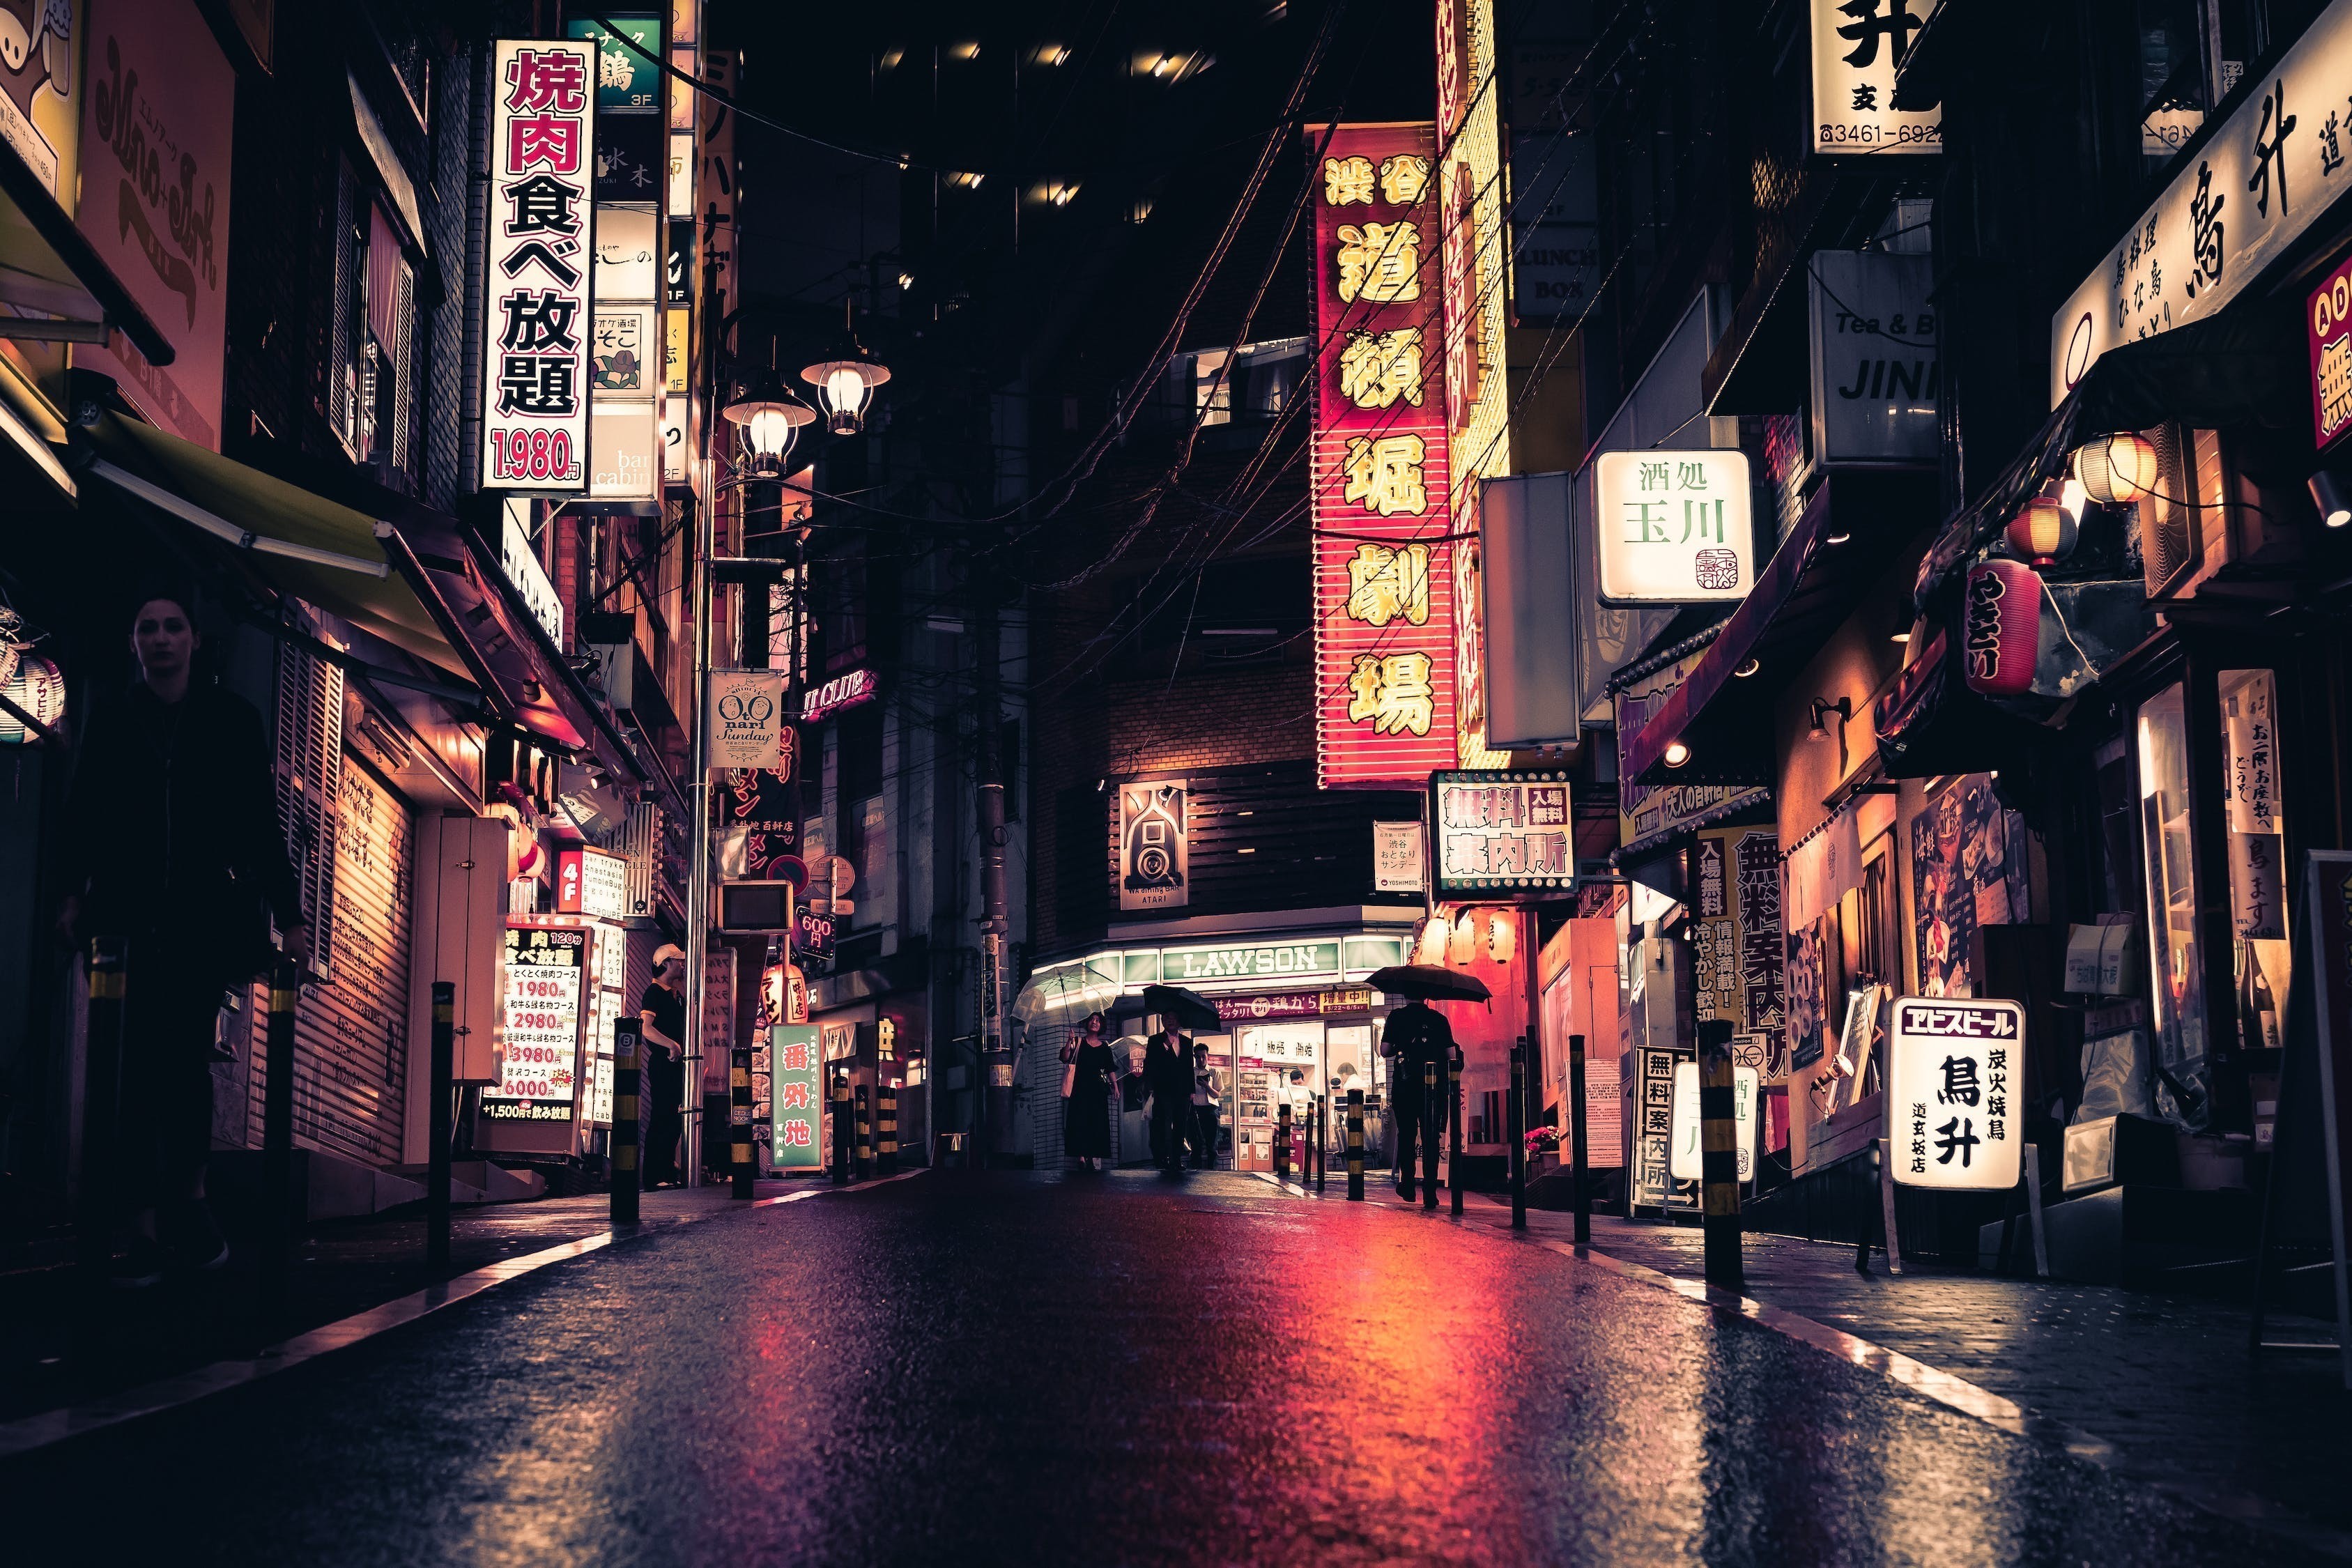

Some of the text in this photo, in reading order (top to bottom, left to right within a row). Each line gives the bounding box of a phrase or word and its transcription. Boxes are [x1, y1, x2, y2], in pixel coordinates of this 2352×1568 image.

[631, 95, 651, 105] 3F
[1325, 155, 1431, 207] 渋谷
[2186, 78, 2296, 298] 鳥升
[498, 49, 587, 417] 焼肉食べ放題
[2114, 213, 2158, 289] 鳥料理
[2119, 259, 2161, 328] ひな鳥
[1836, 313, 1880, 334] Tea
[2128, 301, 2171, 343] きとり
[594, 330, 636, 348] そこ
[671, 379, 683, 390] 1F
[491, 429, 581, 481] 1,980円
[618, 449, 651, 468] bar
[596, 466, 652, 486] cabin
[665, 468, 679, 479] 2F
[1337, 222, 1435, 736] 道頓堀劇場
[1639, 461, 1707, 491] 酒処
[1623, 499, 1724, 544] 玉川
[820, 670, 864, 707] CLUB
[716, 729, 774, 744] Sunday
[1444, 787, 1525, 828] 無料
[1532, 790, 1563, 806] 入場
[1532, 807, 1564, 824] 無料
[763, 821, 794, 831] 百軒店
[1389, 840, 1407, 848] 渋谷
[1446, 831, 1567, 874] 案内所
[601, 859, 622, 870] tryke
[1381, 850, 1415, 859] おとなり
[585, 864, 622, 879] Anastasia
[1381, 861, 1416, 869] サンデー
[563, 863, 578, 901] 4F
[1700, 841, 1723, 916] 入場無料
[1142, 896, 1167, 904] ATARI
[584, 905, 620, 919] A-TROUPE
[802, 915, 831, 936] 600
[551, 933, 582, 945] 120分
[810, 934, 822, 948] 円
[1183, 945, 1319, 978] LAWSON
[1714, 921, 1737, 1008] 情報満載!
[514, 969, 577, 978] とくとく焼肉コース
[516, 981, 566, 997] 1980円
[762, 977, 780, 1024] ラーメン
[1254, 1000, 1267, 1014] 新
[513, 1013, 563, 1029] 2980円
[512, 1047, 561, 1064] 3980円
[504, 1080, 555, 1096] 6000円
[783, 1043, 811, 1146] 番外地
[1988, 1048, 2008, 1141] 炭火焼鳥
[1646, 1054, 1671, 1186] 無料案内所
[1935, 1055, 1981, 1169] 鳥升
[776, 1123, 785, 1158] 百軒店
